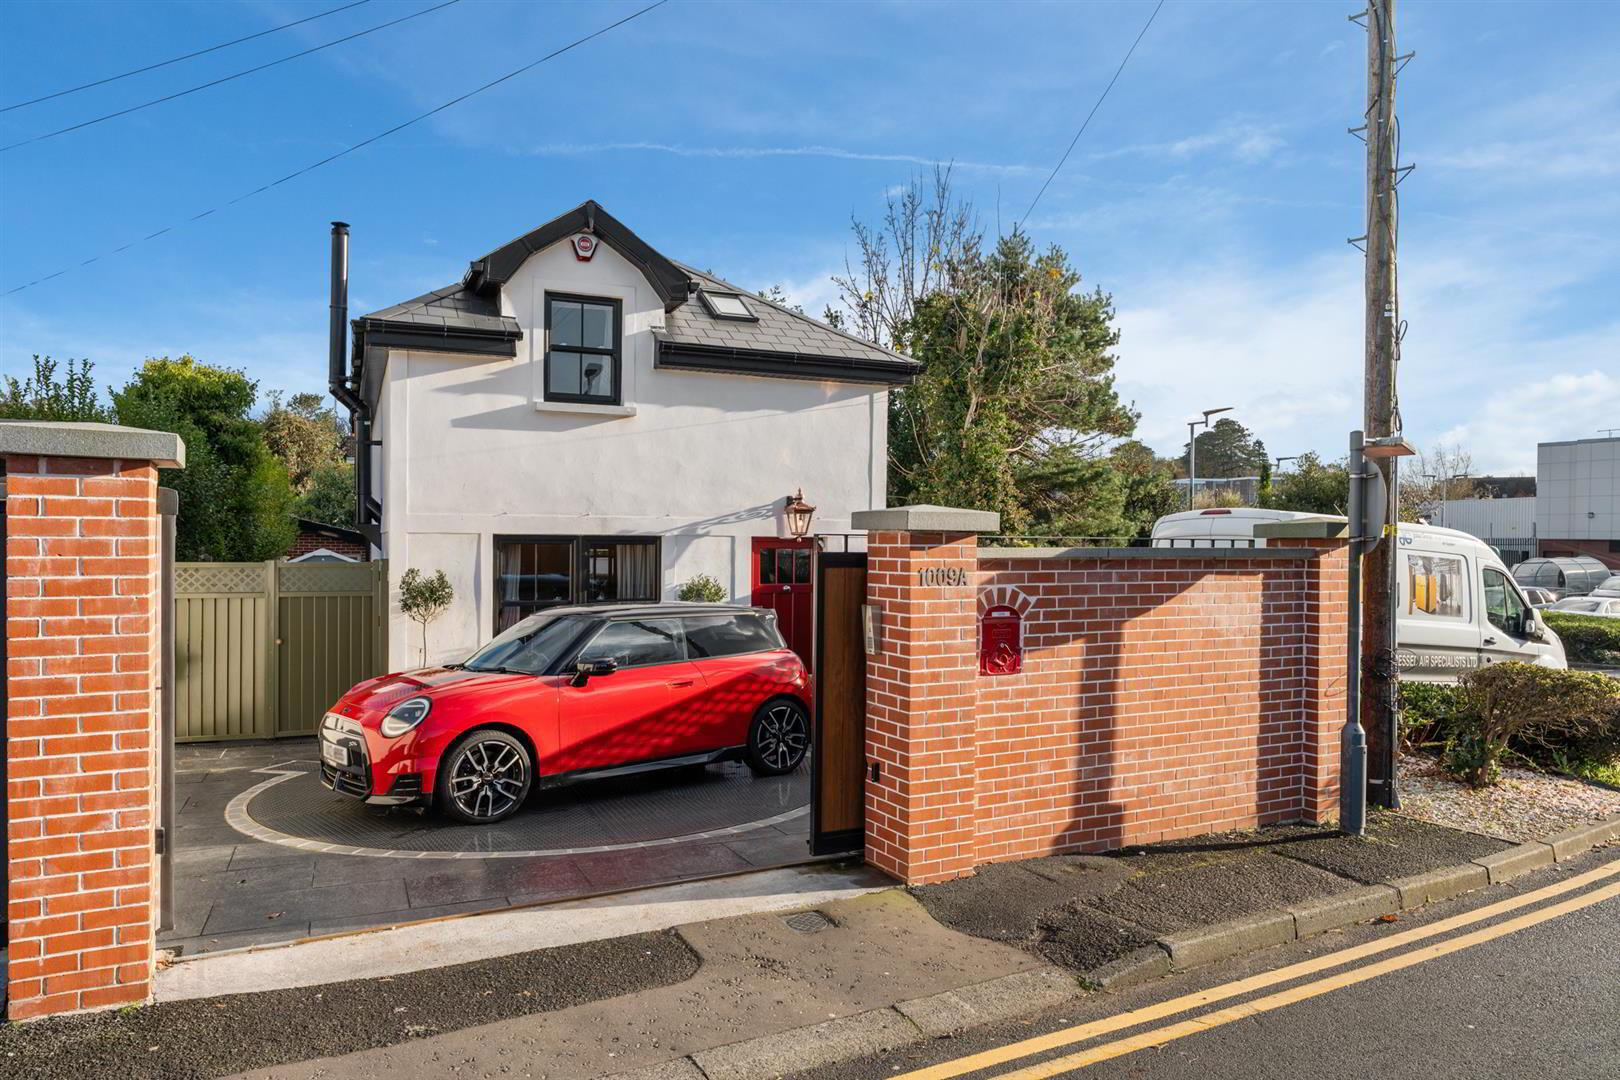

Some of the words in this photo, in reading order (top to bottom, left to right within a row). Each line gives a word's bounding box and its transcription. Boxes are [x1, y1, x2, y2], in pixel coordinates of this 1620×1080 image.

[918, 567, 968, 587] 1009A
[1419, 655, 1430, 667] AIR
[1430, 655, 1466, 668] SPECIALISTS
[1467, 656, 1478, 668] LTD
